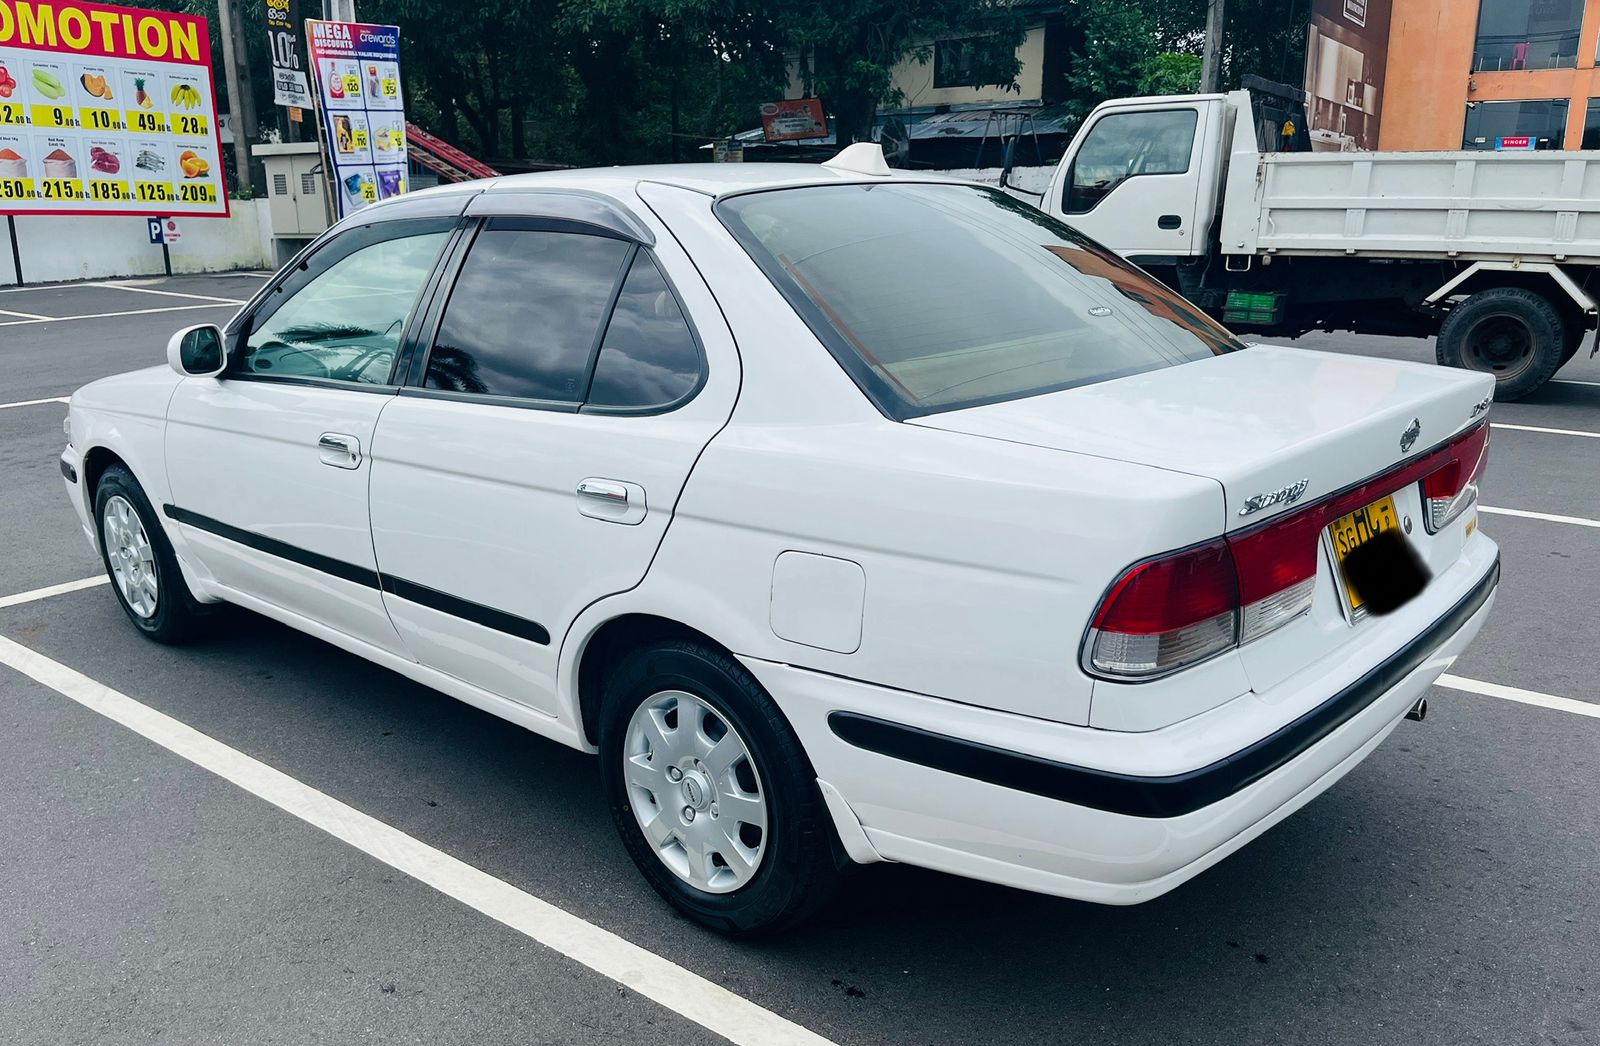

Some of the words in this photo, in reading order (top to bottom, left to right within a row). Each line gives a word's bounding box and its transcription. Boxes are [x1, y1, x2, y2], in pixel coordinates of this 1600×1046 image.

[313, 23, 351, 40] MEGA
[314, 39, 354, 49] DISCOUNTS
[150, 222, 161, 240] P
[1239, 478, 1309, 516] Sunny
